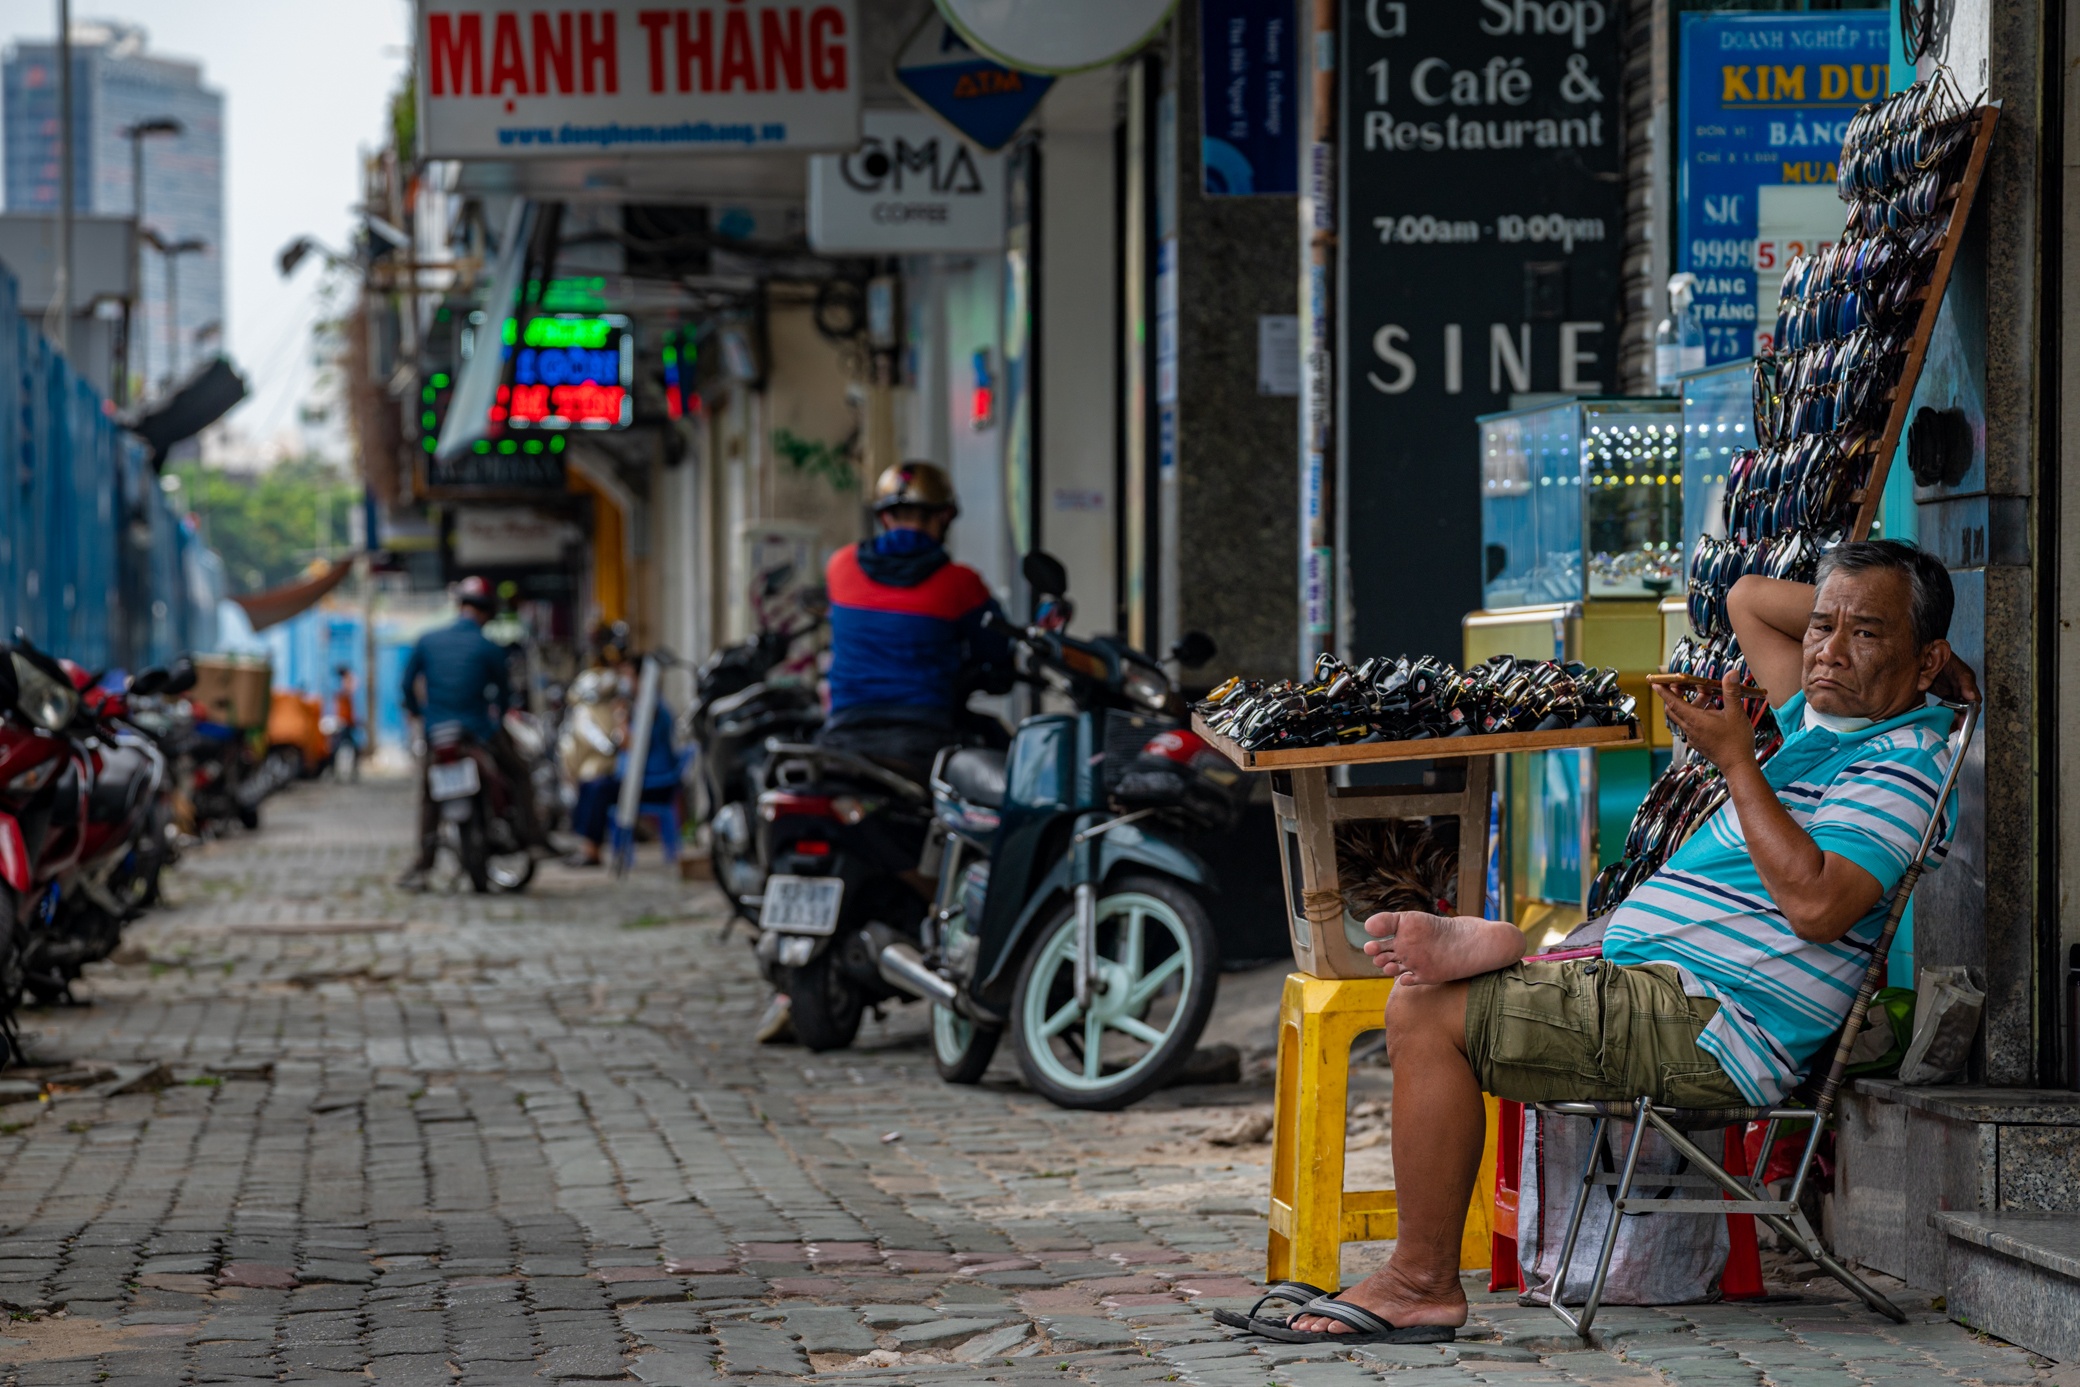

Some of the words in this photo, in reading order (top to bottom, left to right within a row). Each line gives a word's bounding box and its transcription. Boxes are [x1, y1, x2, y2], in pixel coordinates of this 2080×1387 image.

[1479, 0, 1605, 49] Shop
[1721, 30, 1784, 49] DOANH
[429, 12, 618, 114] MẠNH
[953, 70, 1022, 98] ATM
[1366, 57, 1390, 105] 1
[1410, 55, 1532, 106] Café
[1559, 53, 1604, 104] &
[1722, 65, 1806, 100] KIM
[1818, 64, 1890, 100] DU
[1364, 110, 1602, 151] Restaurant
[1782, 162, 1838, 183] MUA
[871, 201, 949, 225] COFFEE
[1704, 195, 1744, 224] SJC
[1692, 239, 1755, 268] 9999
[1694, 275, 1747, 294] VÀNG
[1709, 327, 1739, 356] 75
[1367, 322, 1604, 394] SINE
